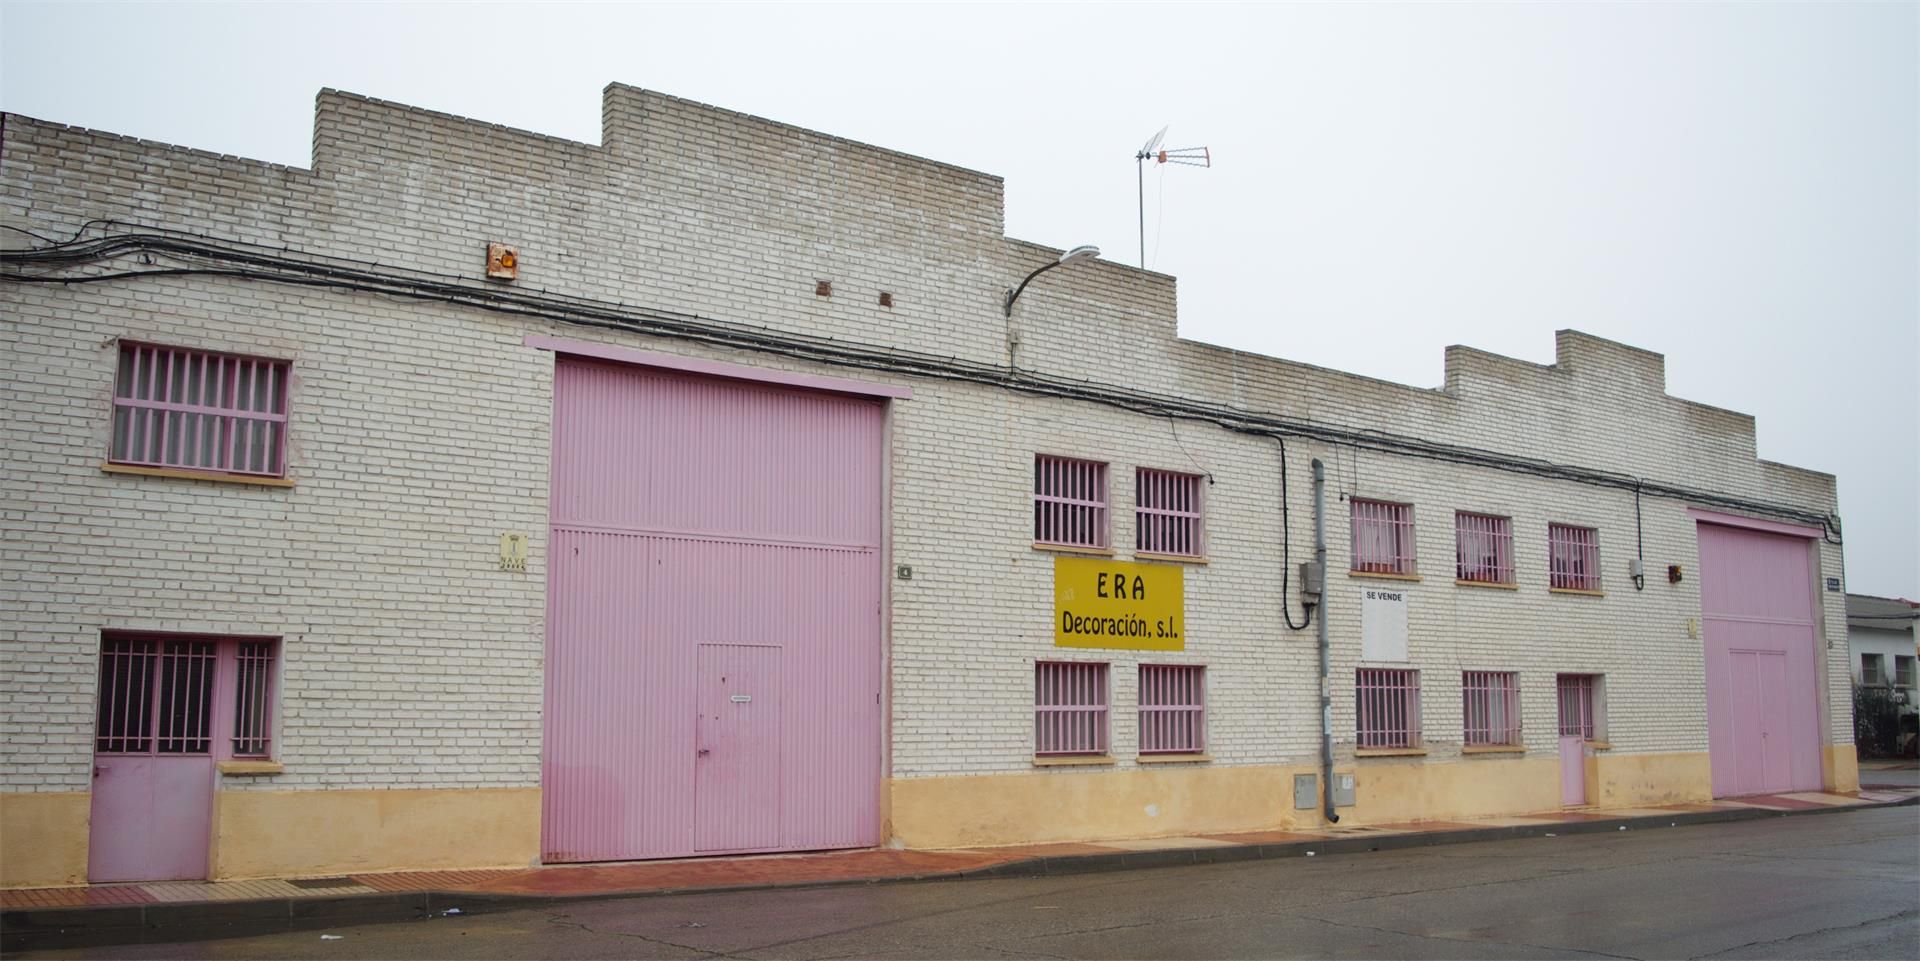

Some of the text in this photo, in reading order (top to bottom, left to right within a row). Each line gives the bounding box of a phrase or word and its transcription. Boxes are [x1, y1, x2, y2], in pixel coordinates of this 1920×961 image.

[1097, 572, 1145, 600] ERA
[1366, 591, 1402, 602] SE VENDE
[1063, 610, 1178, 639] Decoración, s.l.
